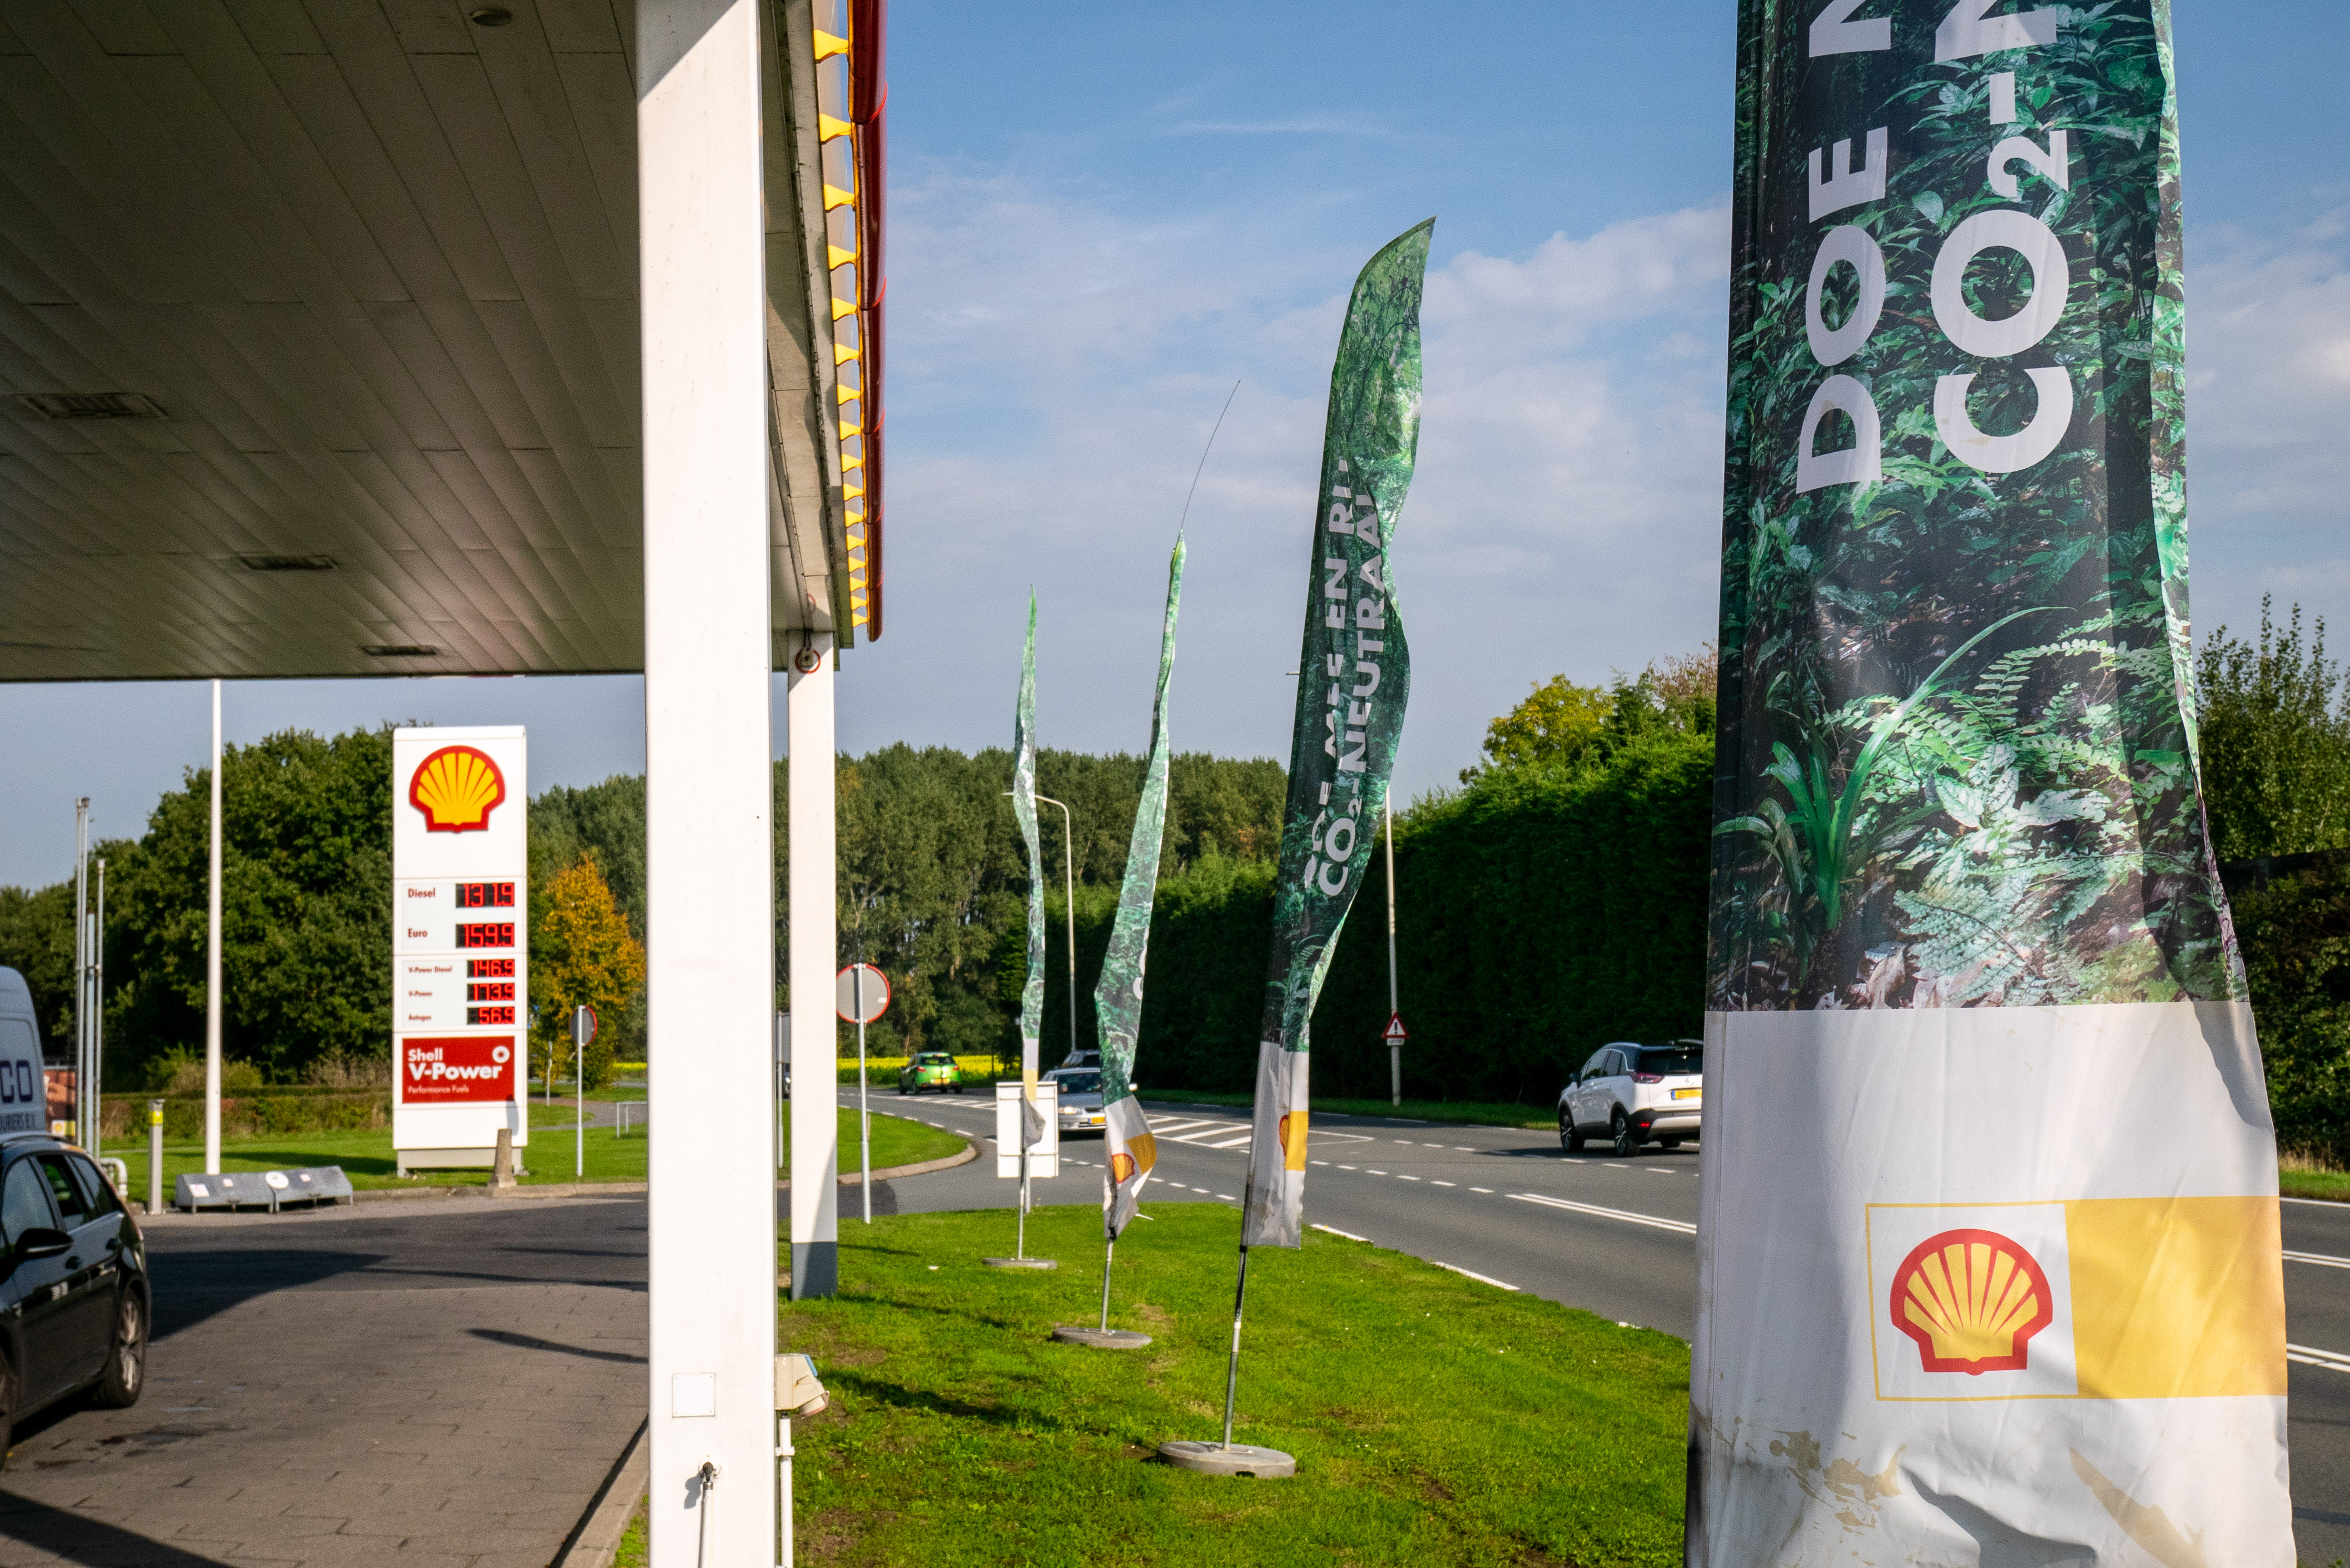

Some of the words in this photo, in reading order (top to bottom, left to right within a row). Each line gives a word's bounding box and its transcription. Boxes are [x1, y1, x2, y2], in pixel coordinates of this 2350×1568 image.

[1796, 126, 1888, 494] DOE
[1324, 557, 1348, 630] EN
[408, 887, 436, 898] Diesel
[408, 928, 428, 938] Euro
[463, 923, 514, 948] 159.9
[473, 960, 515, 977] 146.9
[473, 983, 515, 1002] 173.9
[479, 1007, 515, 1024] 56.9
[408, 1047, 443, 1062] Shell
[408, 1062, 503, 1080] V-Power
